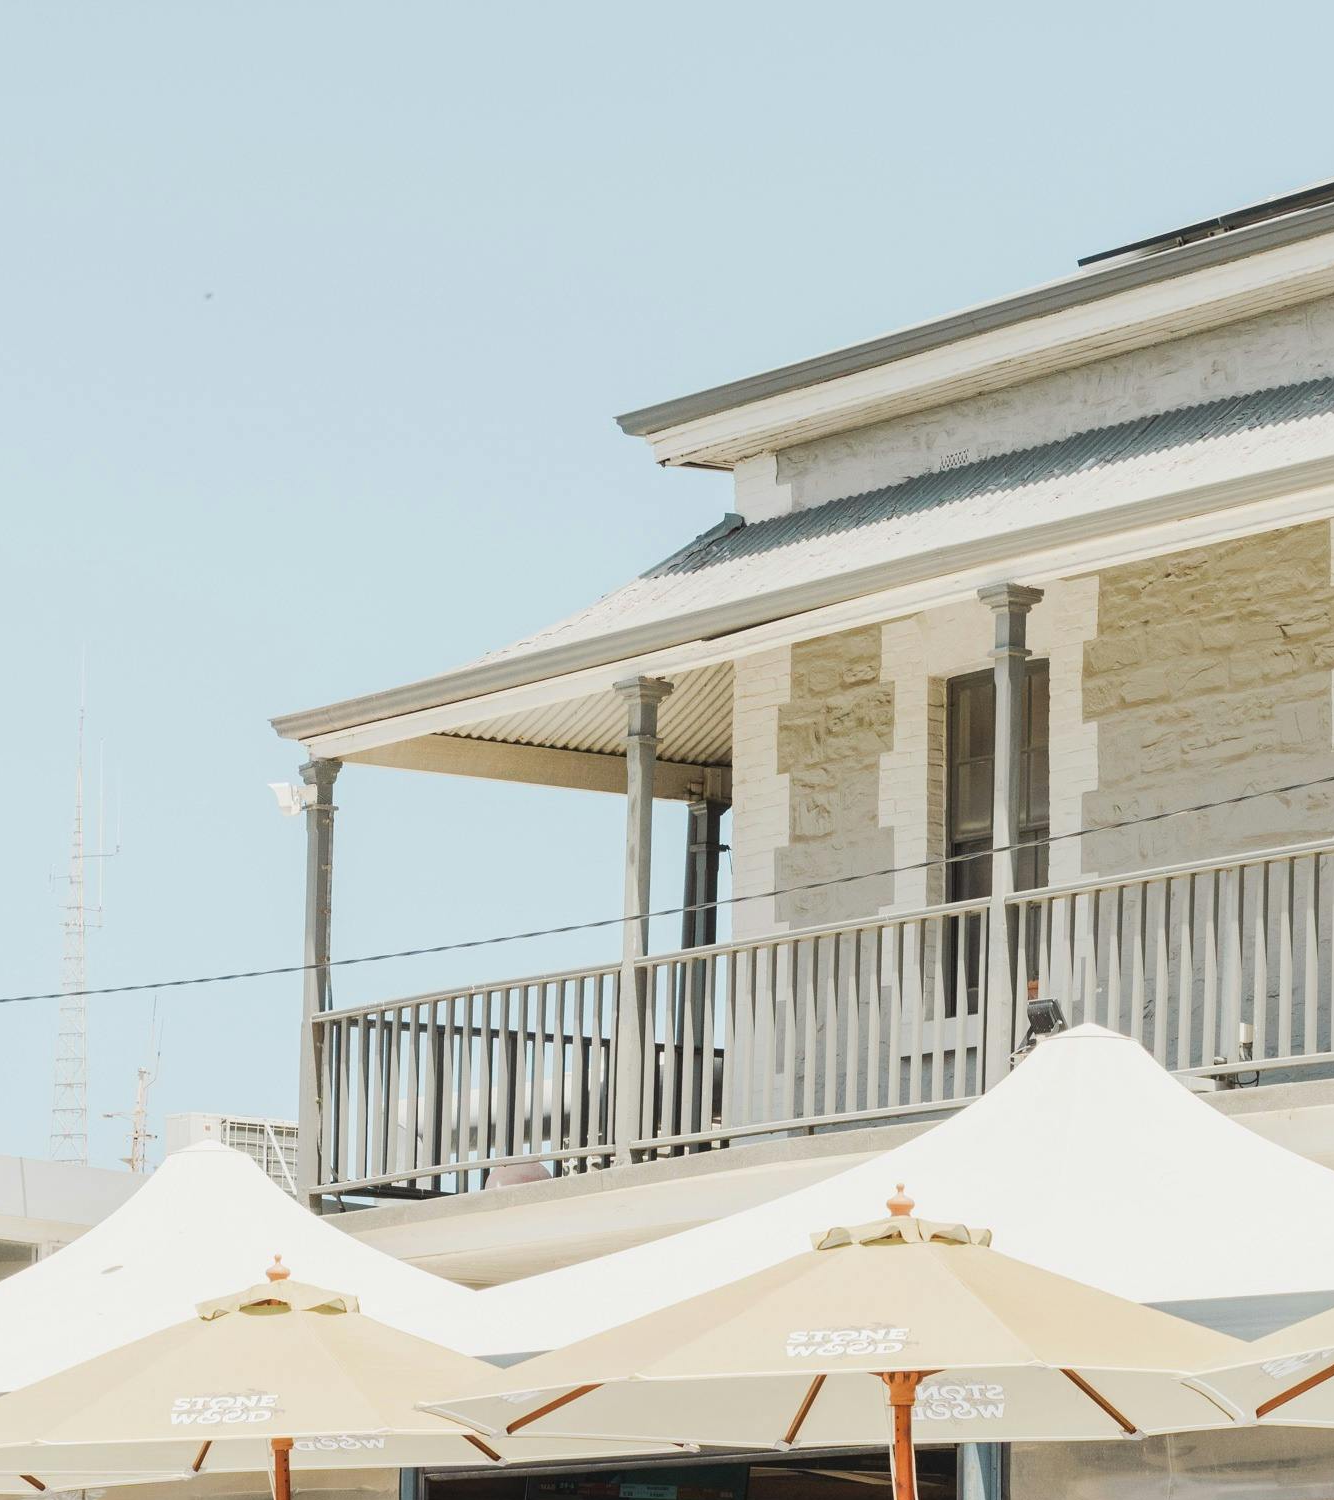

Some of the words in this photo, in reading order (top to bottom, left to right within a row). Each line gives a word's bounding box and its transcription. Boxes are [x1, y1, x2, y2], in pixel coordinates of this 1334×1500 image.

[787, 1328, 909, 1344] STONE
[786, 1342, 903, 1357] WOOD
[172, 1395, 279, 1411] STONE
[171, 1410, 272, 1425] WOOD
